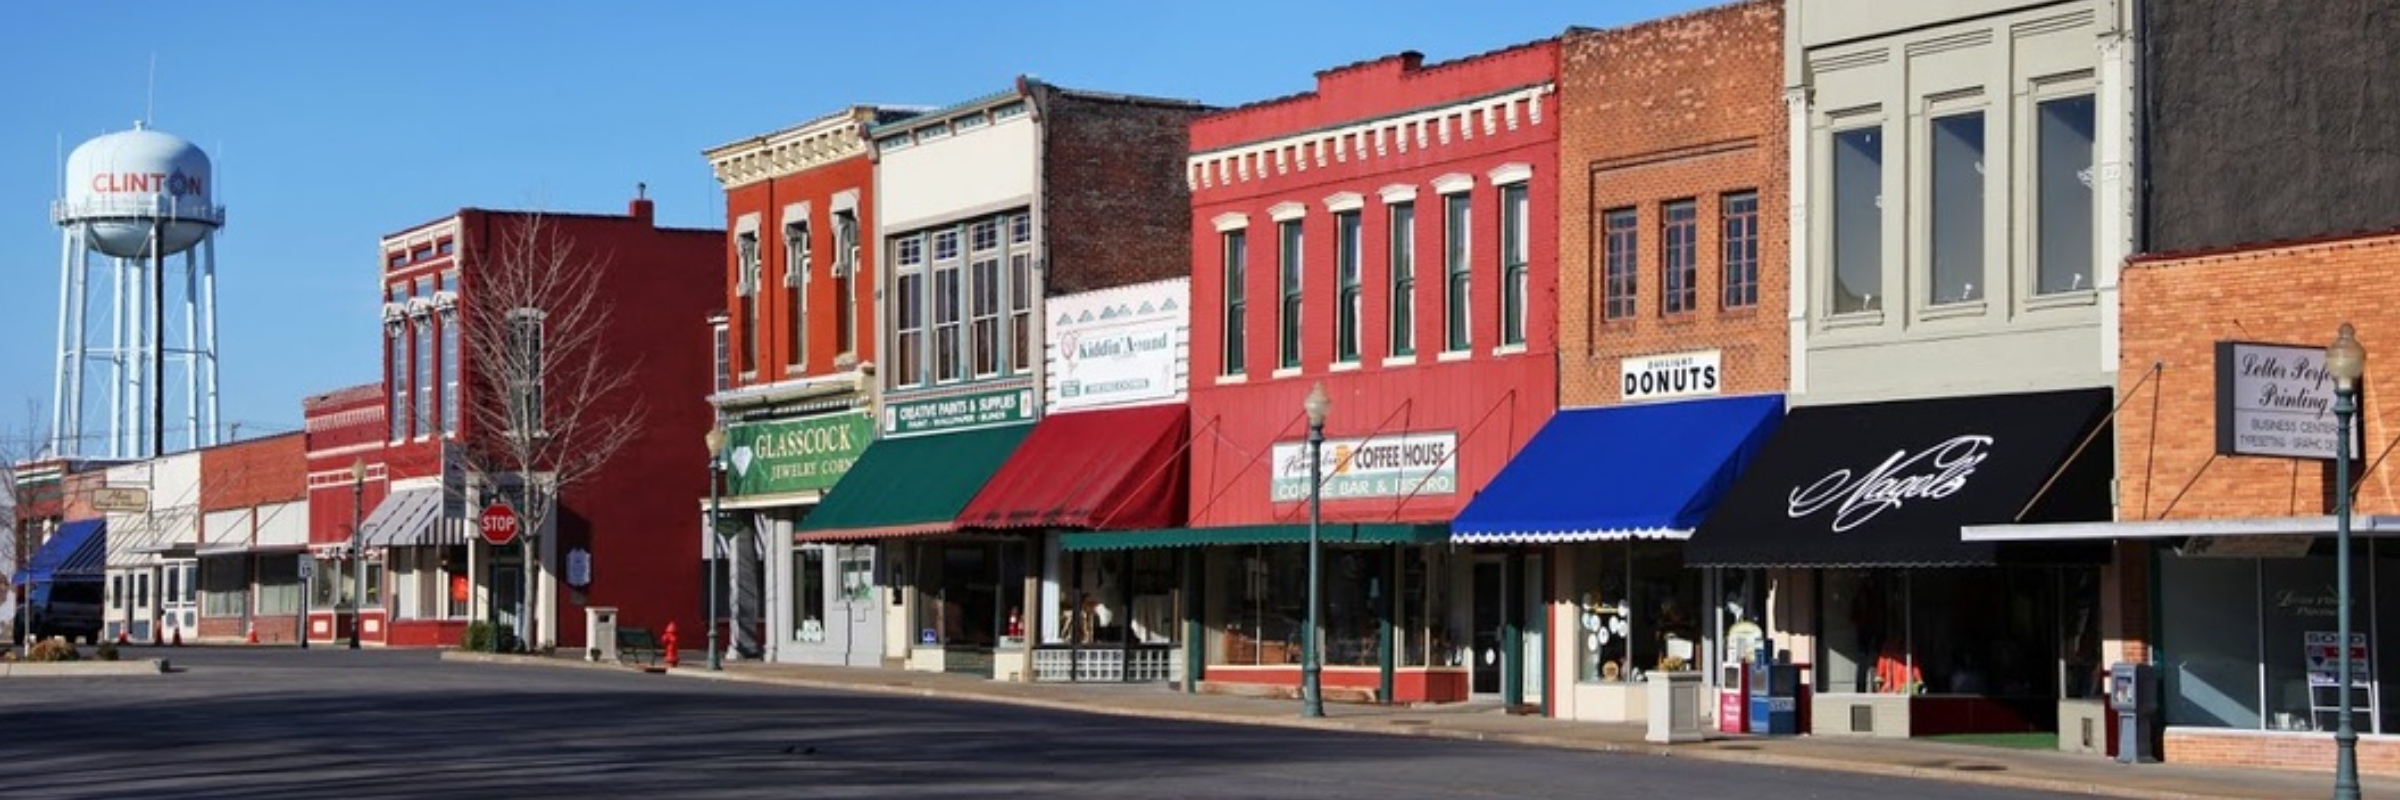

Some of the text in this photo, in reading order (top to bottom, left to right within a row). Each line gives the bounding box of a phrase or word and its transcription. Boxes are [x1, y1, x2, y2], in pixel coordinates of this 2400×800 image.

[92, 172, 202, 197] CLINTON
[1124, 332, 1168, 353] Aound
[1624, 364, 1716, 396] DONUTS
[2240, 353, 2331, 391] Letter Perfe
[900, 394, 1017, 421] CREATIVE PAINTS & SUPPLIES
[2258, 382, 2328, 420] Printing
[906, 419, 928, 429] PAINT
[2251, 418, 2297, 433] BUSINESS
[754, 424, 852, 460] GLASSCOCK
[770, 454, 860, 481] JEWELRY CORN
[1354, 445, 1400, 470] COFFEE
[1403, 442, 1445, 467] HOUSE
[1338, 478, 1370, 496] BAR
[1376, 479, 1388, 495] &
[482, 515, 516, 532] STOP
[2308, 632, 2364, 644] SOD
